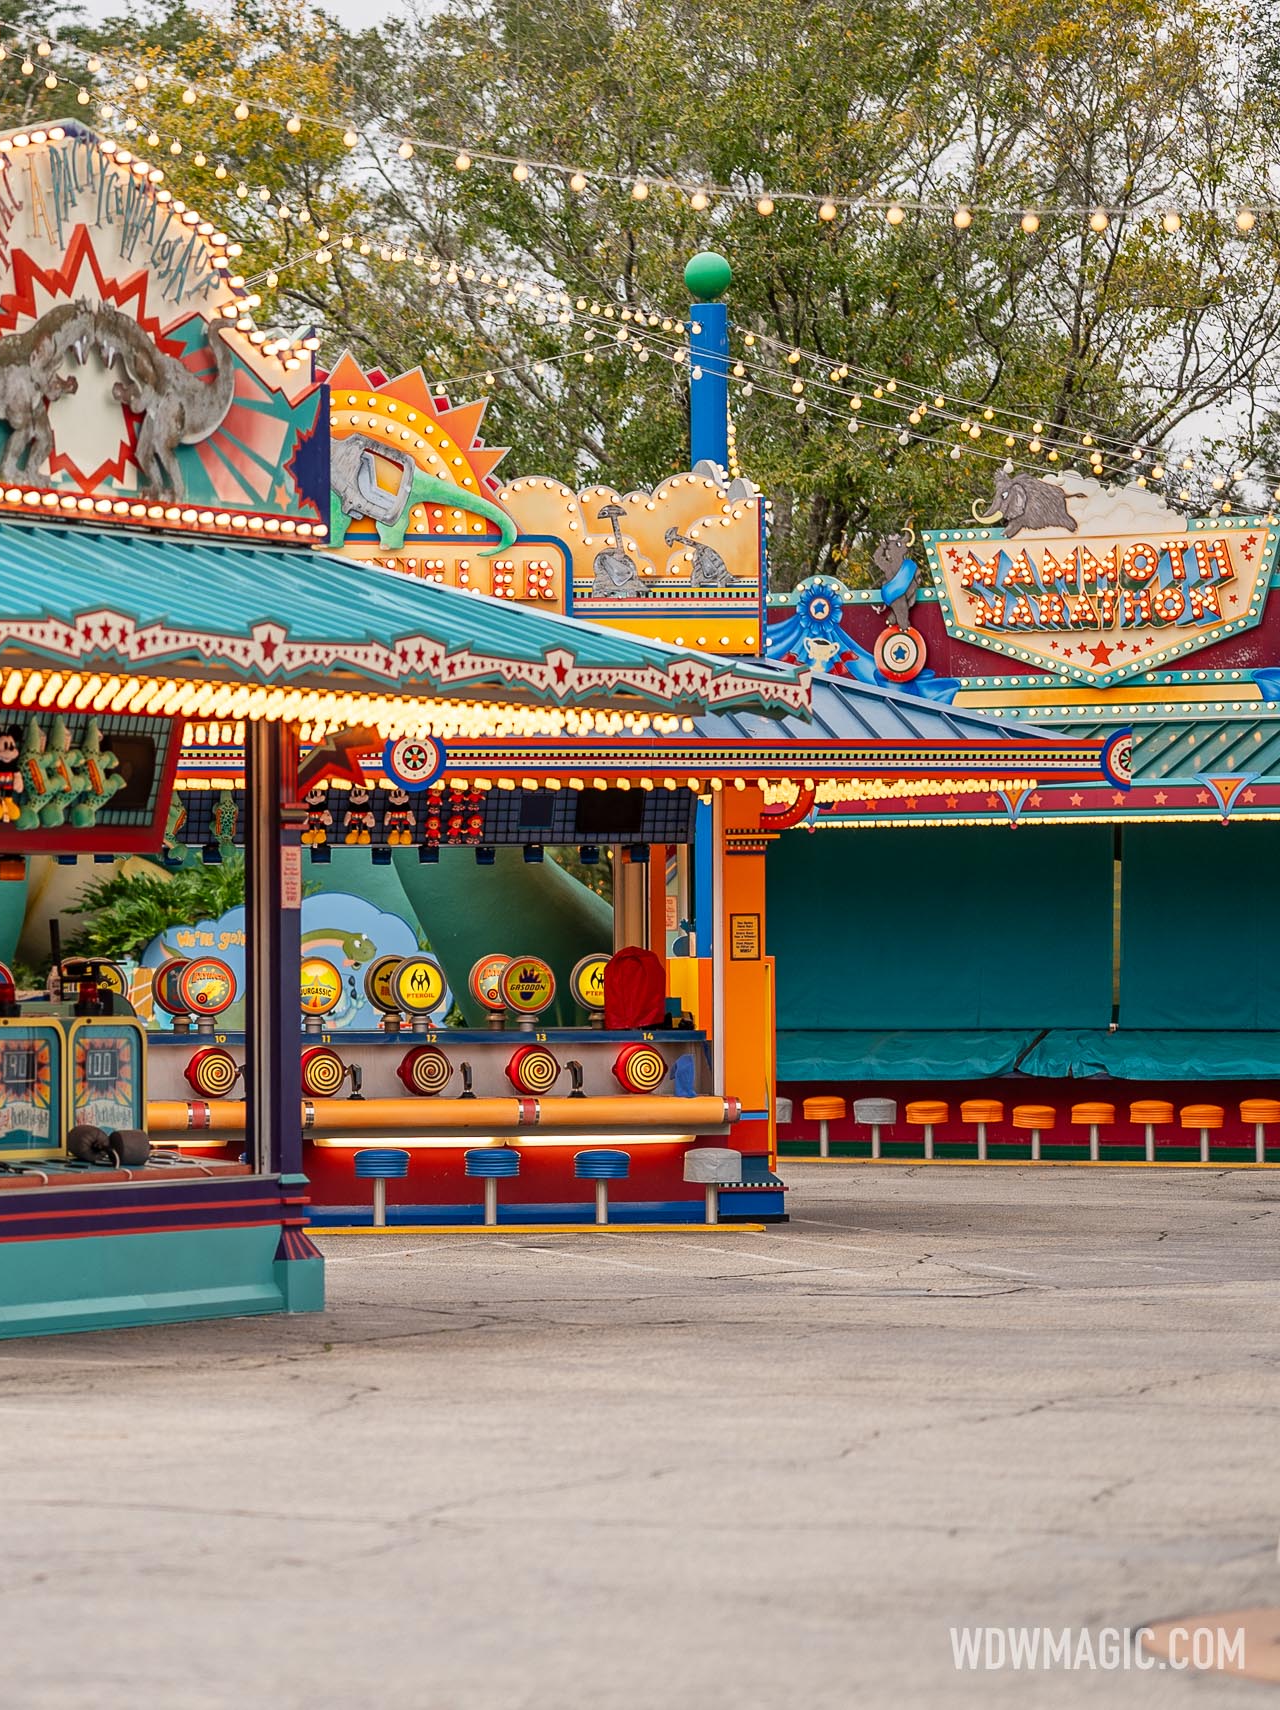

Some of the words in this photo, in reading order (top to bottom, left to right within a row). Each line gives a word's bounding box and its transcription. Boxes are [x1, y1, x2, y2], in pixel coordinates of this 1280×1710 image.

[26, 152, 57, 245] A
[961, 538, 1235, 590] MAMMOTH
[974, 585, 1223, 627] MARATHON
[215, 1035, 227, 1043] 10
[321, 1035, 331, 1043] 11
[426, 1034, 437, 1043] 12
[536, 1033, 547, 1041] 13
[642, 1032, 654, 1041] 14
